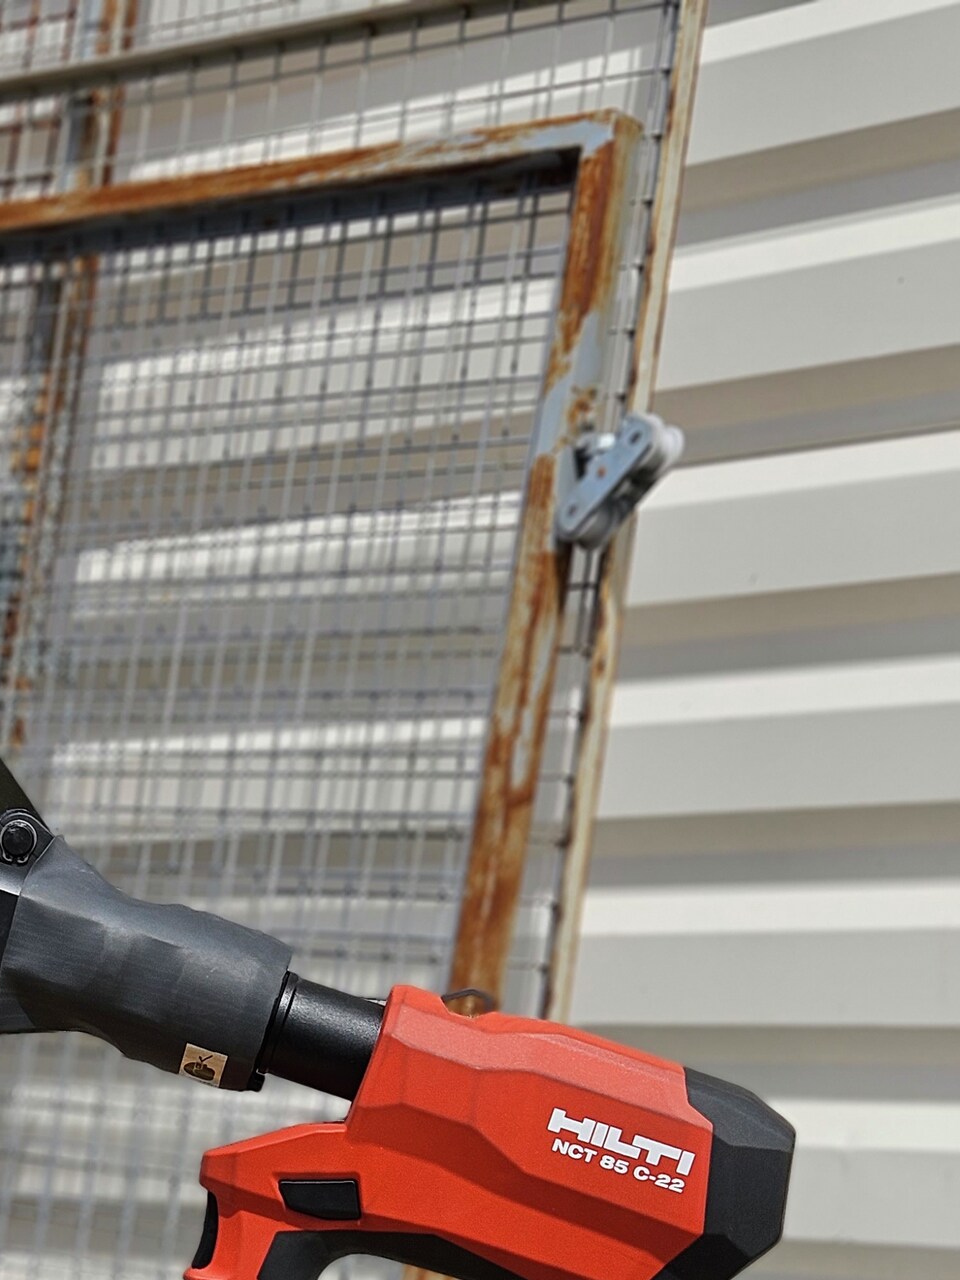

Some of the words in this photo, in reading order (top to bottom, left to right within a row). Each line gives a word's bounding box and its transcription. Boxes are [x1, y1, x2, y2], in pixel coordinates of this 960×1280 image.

[547, 1107, 696, 1177] HILTI
[551, 1138, 598, 1164] NCT
[599, 1155, 630, 1175] 85
[633, 1166, 686, 1194] C-22
